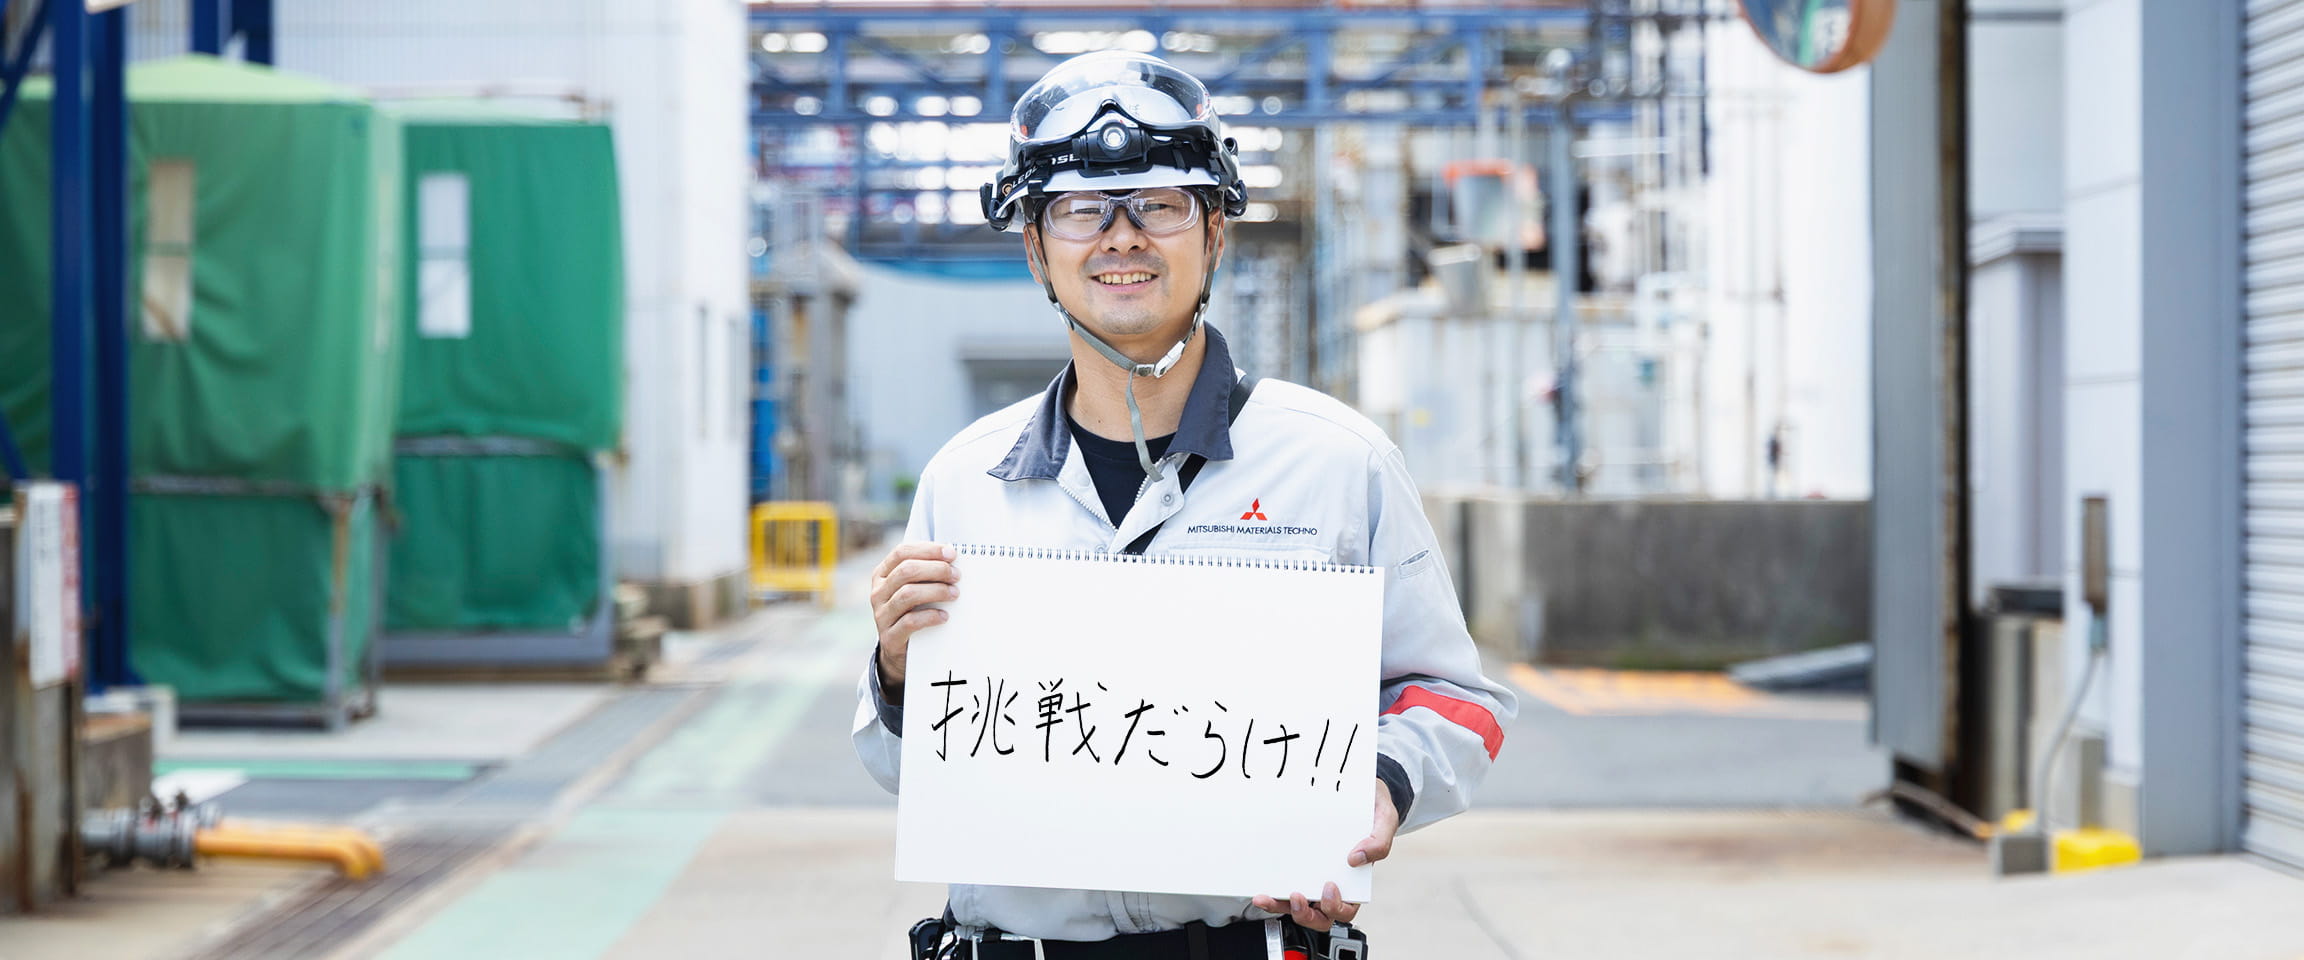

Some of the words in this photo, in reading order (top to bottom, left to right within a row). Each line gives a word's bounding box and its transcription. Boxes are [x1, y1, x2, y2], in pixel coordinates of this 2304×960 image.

[1187, 525, 1235, 534] MITSUBISHI
[1236, 525, 1282, 535] MATERIALS
[1283, 526, 1318, 536] TECHNO
[930, 669, 1359, 793] 挑戦だらけ!!
